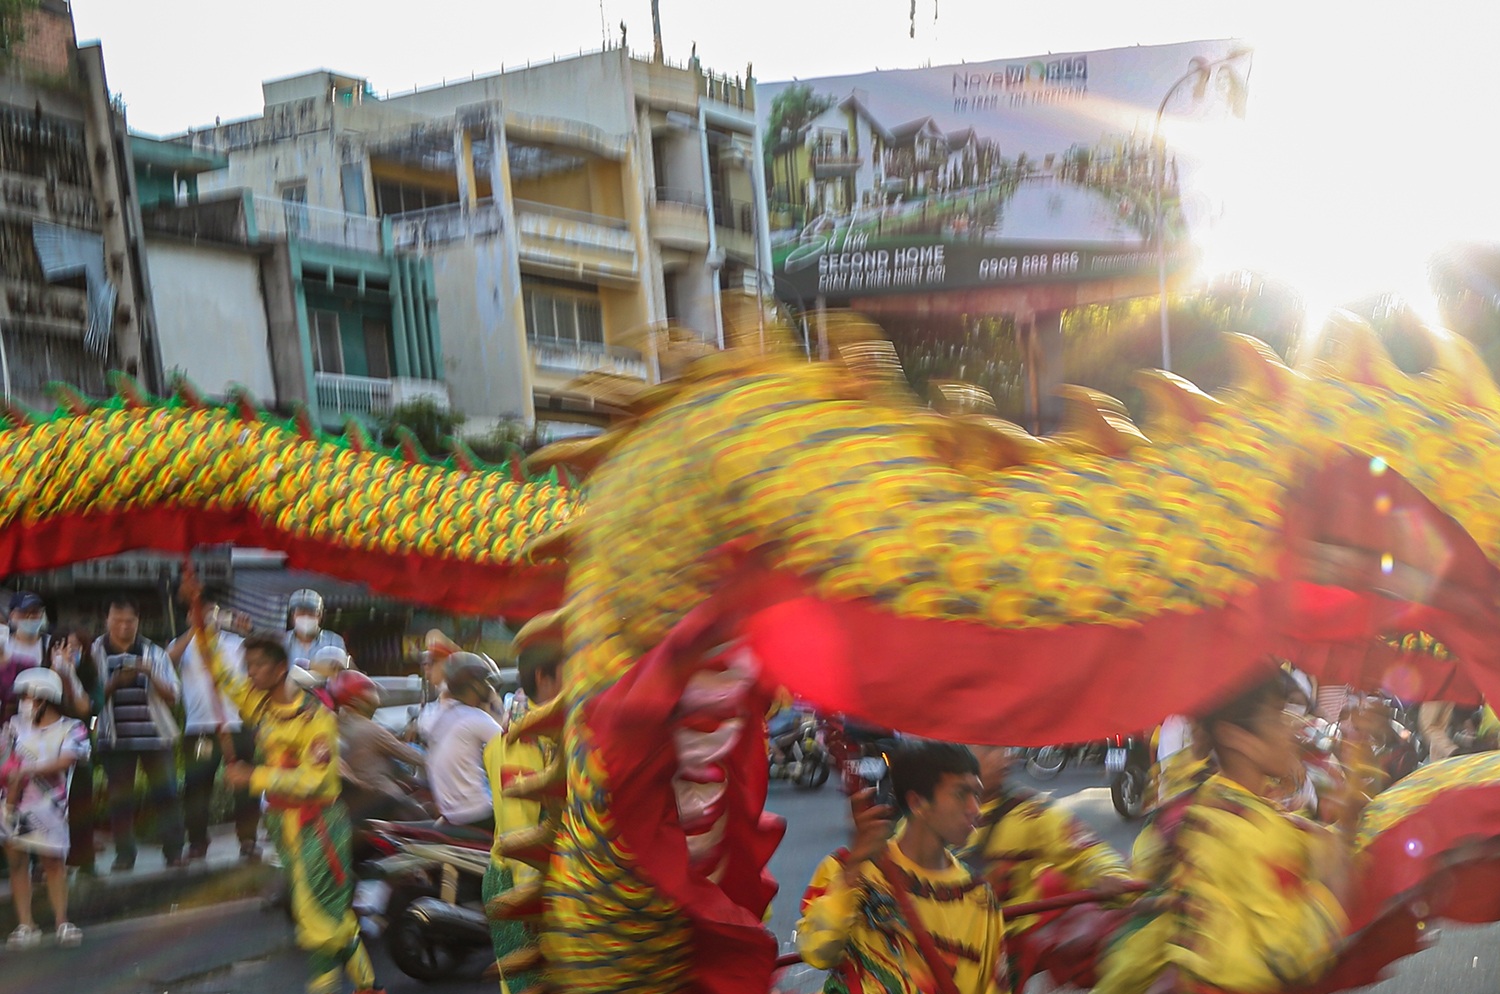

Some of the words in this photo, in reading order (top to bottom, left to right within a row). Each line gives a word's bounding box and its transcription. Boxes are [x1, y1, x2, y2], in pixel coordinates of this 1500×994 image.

[819, 250, 889, 272] SECOND
[894, 245, 944, 267] HOME
[979, 257, 1018, 279] 0909
[1021, 253, 1048, 276] 888
[1052, 251, 1079, 273] 886
